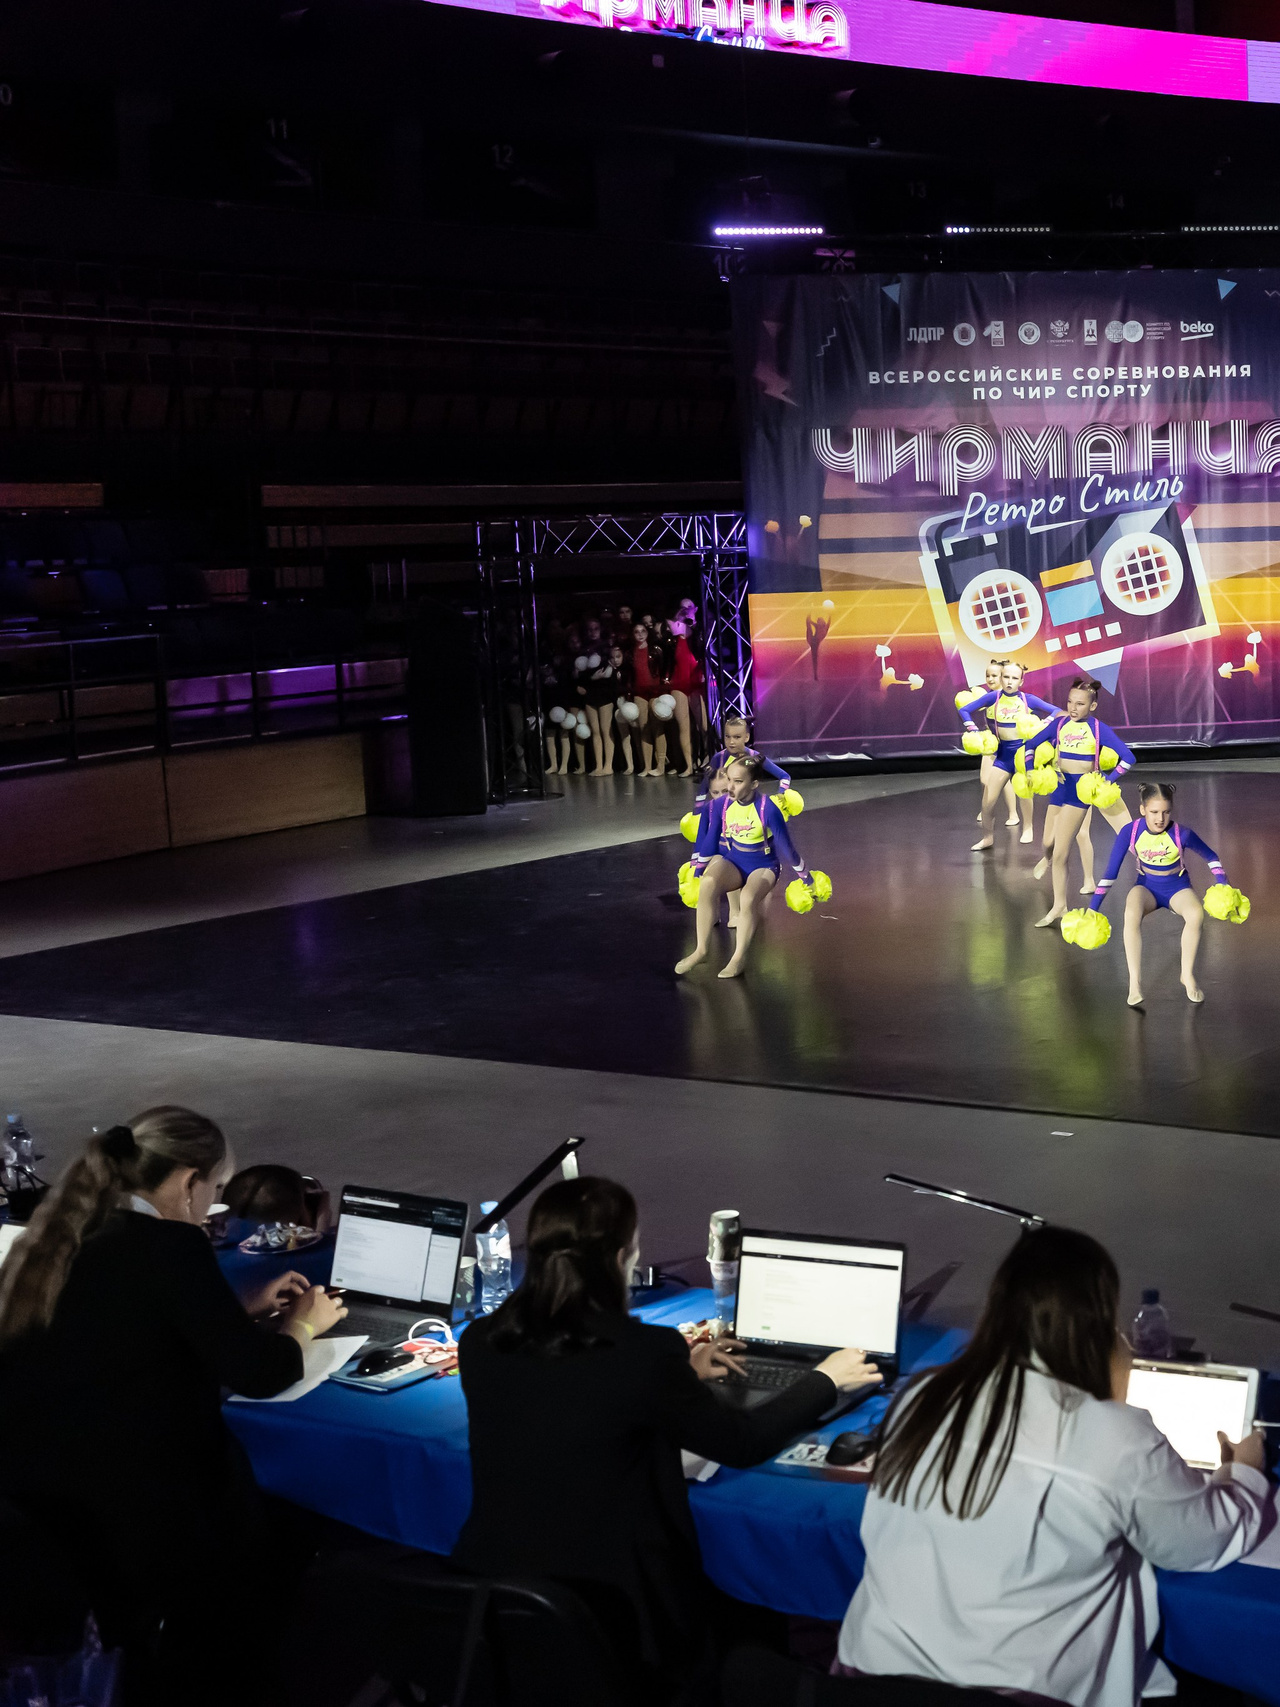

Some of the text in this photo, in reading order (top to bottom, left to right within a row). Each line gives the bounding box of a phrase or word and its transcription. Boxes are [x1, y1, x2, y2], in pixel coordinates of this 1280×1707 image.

[906, 326, 945, 344] ЛДПР
[1180, 320, 1215, 334] beko
[868, 364, 1252, 384] ВСЕРОССИЙСКИЕ СОРЕВНОВАНИЯ
[973, 384, 1152, 400] ПО ЧИР СПОРТУ
[961, 473, 1184, 534] Ретро Стиль
